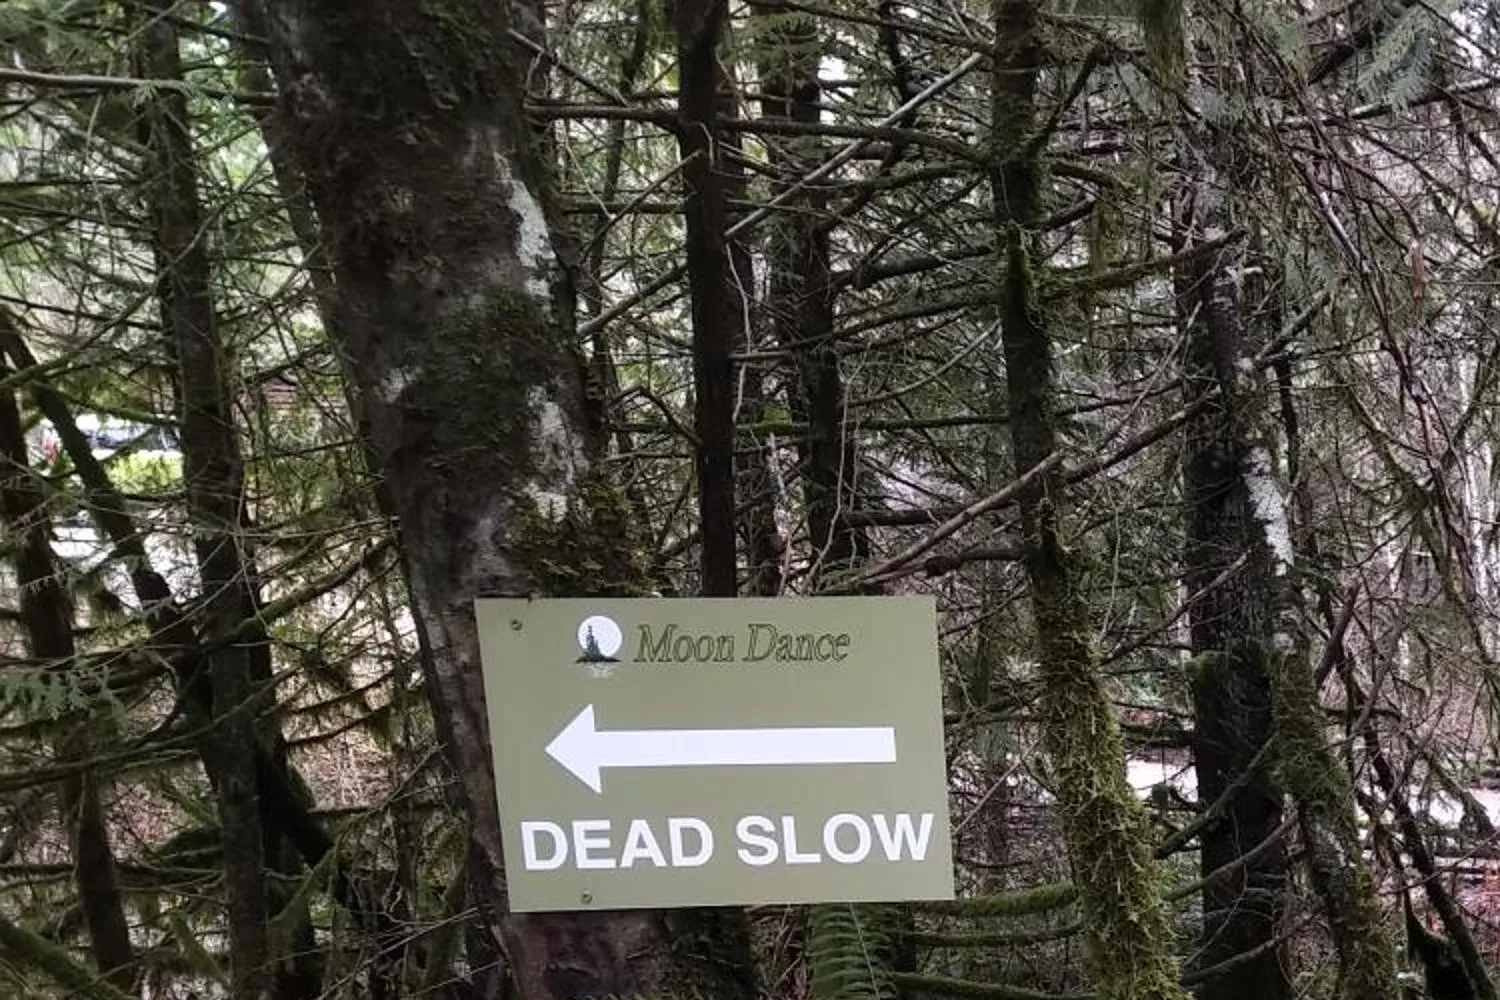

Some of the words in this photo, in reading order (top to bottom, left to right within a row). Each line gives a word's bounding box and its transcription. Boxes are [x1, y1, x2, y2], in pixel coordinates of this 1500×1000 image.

[633, 624, 736, 663] Moon
[742, 622, 851, 662] Dance
[520, 817, 714, 871] DEAD
[736, 812, 934, 866] SLOW
